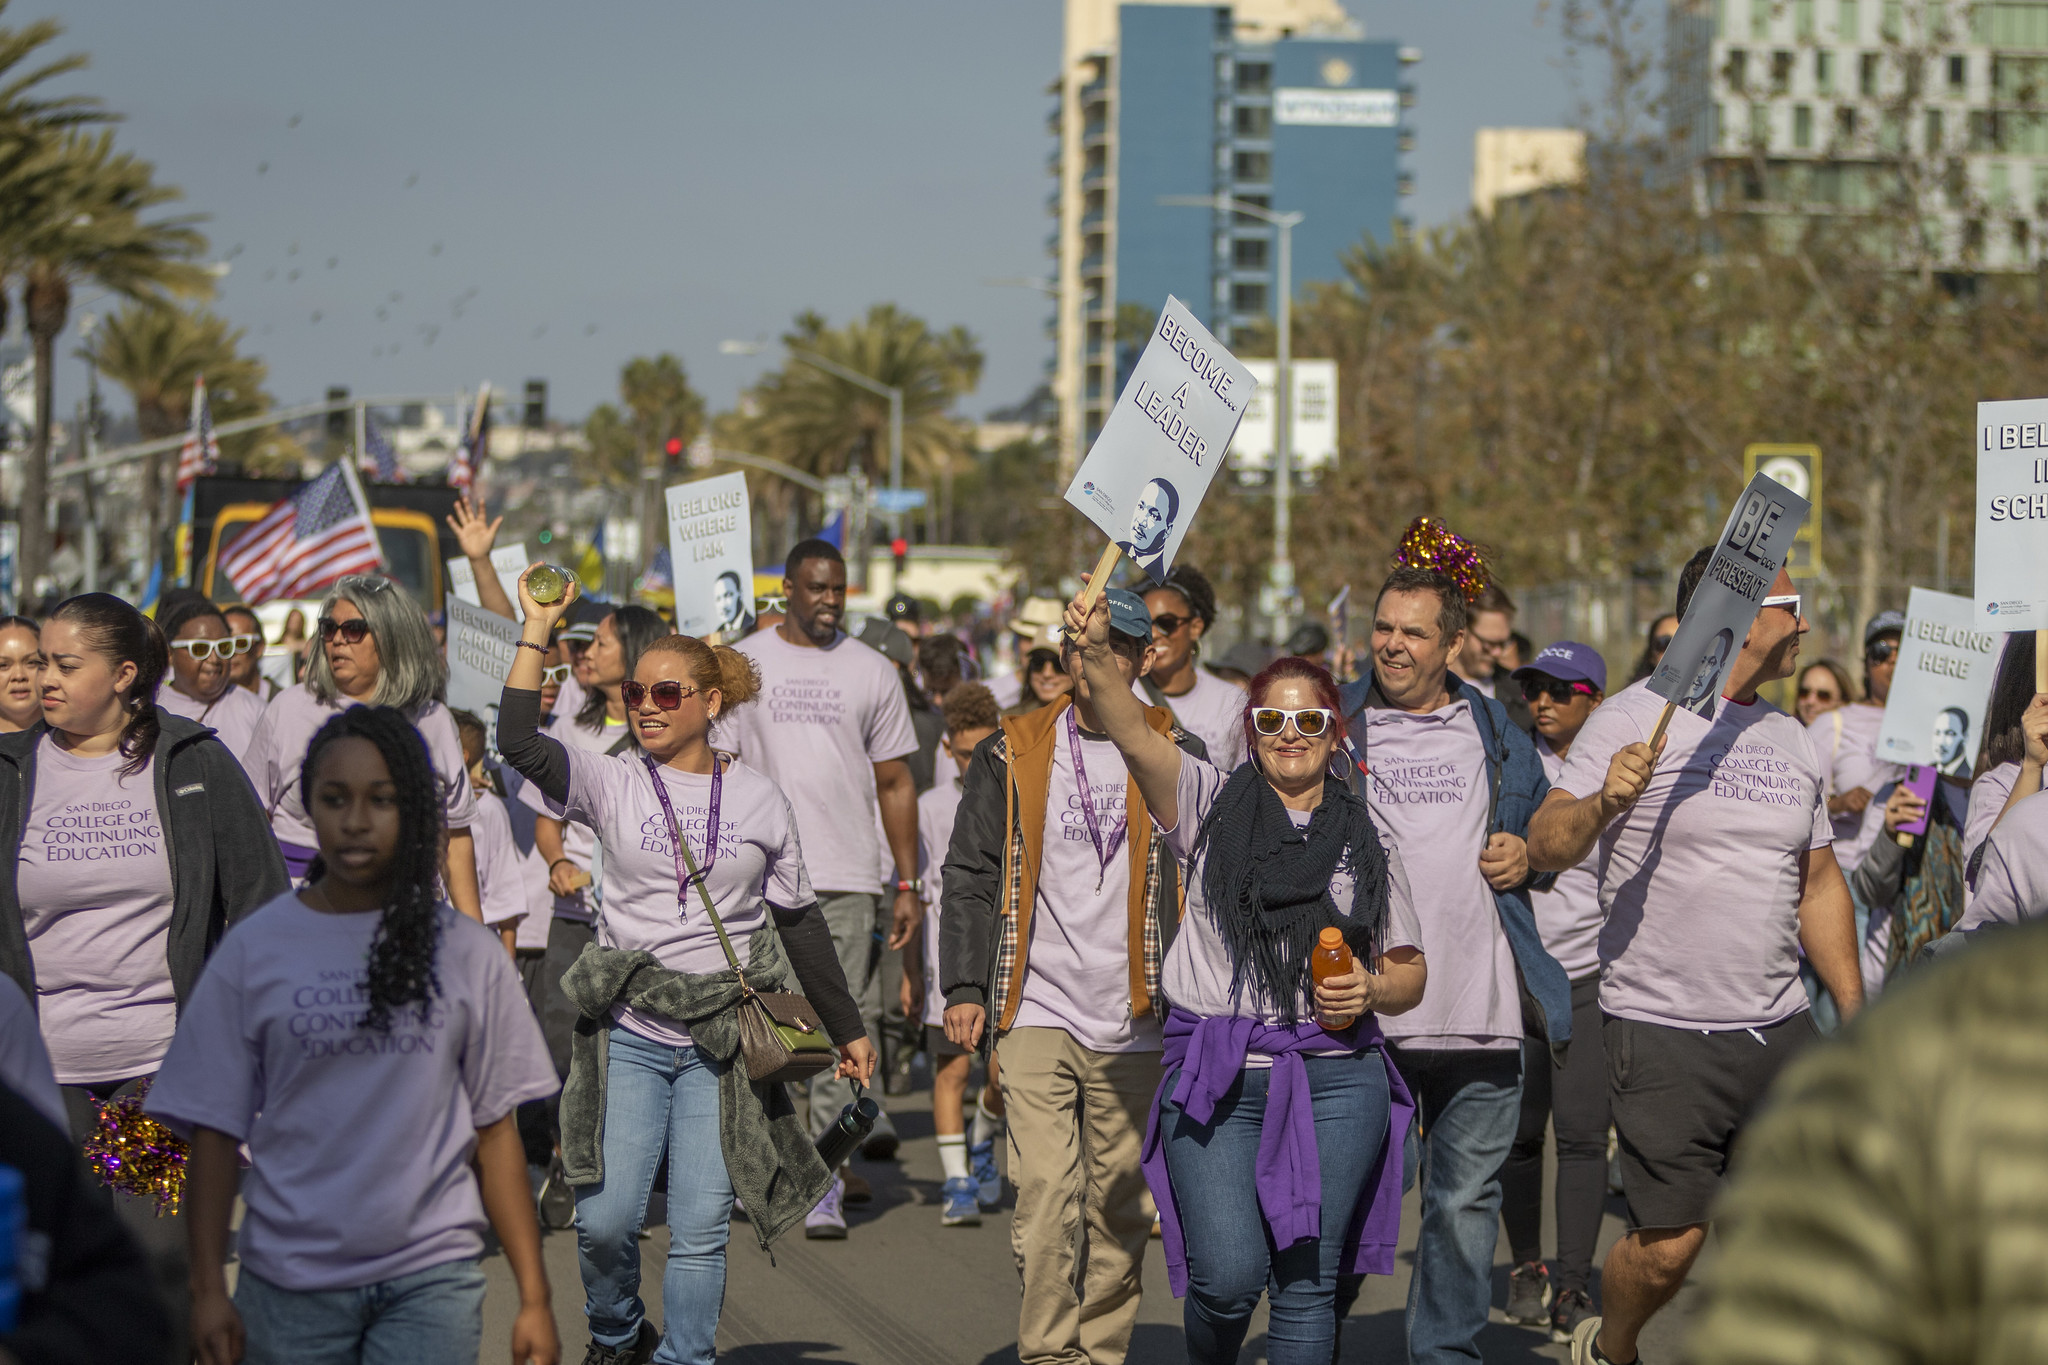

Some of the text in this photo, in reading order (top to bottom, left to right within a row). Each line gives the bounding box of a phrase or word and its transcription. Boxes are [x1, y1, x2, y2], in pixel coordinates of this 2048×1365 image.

[1159, 314, 1237, 411] BECOME...
[1171, 381, 1190, 409] A
[1134, 381, 1208, 467] LEADER
[1984, 425, 1992, 451] I
[671, 490, 743, 521] I BELONG
[679, 515, 736, 542] WHERE
[1726, 489, 1786, 571] BE...
[692, 541, 725, 563] I AM
[1709, 554, 1768, 602] PRESENT
[458, 626, 512, 665] A ROLE
[1908, 619, 1995, 654] I BELONG
[458, 645, 507, 683] MODEL
[1919, 652, 1970, 680] HERE
[772, 686, 841, 699] COLLEGE OF
[768, 699, 846, 713] CONTINUING
[773, 712, 841, 725] EDUCATION
[1724, 744, 1774, 755] SAN DIEGO
[1384, 756, 1405, 766] SAN
[1438, 764, 1457, 776] OF
[1710, 754, 1791, 773] COLLEGE OF
[1708, 769, 1801, 791] CONTINUING
[1068, 794, 1127, 810] CLLEG
[1379, 791, 1463, 805] EDUCATION
[1714, 782, 1802, 807] EDUCATION
[66, 800, 131, 814] SAN DIEGO
[47, 809, 152, 828] COLLEGE OF
[42, 825, 160, 844] CONTINUING
[47, 842, 157, 861] EDUCATION
[288, 1008, 445, 1037] CONTING
